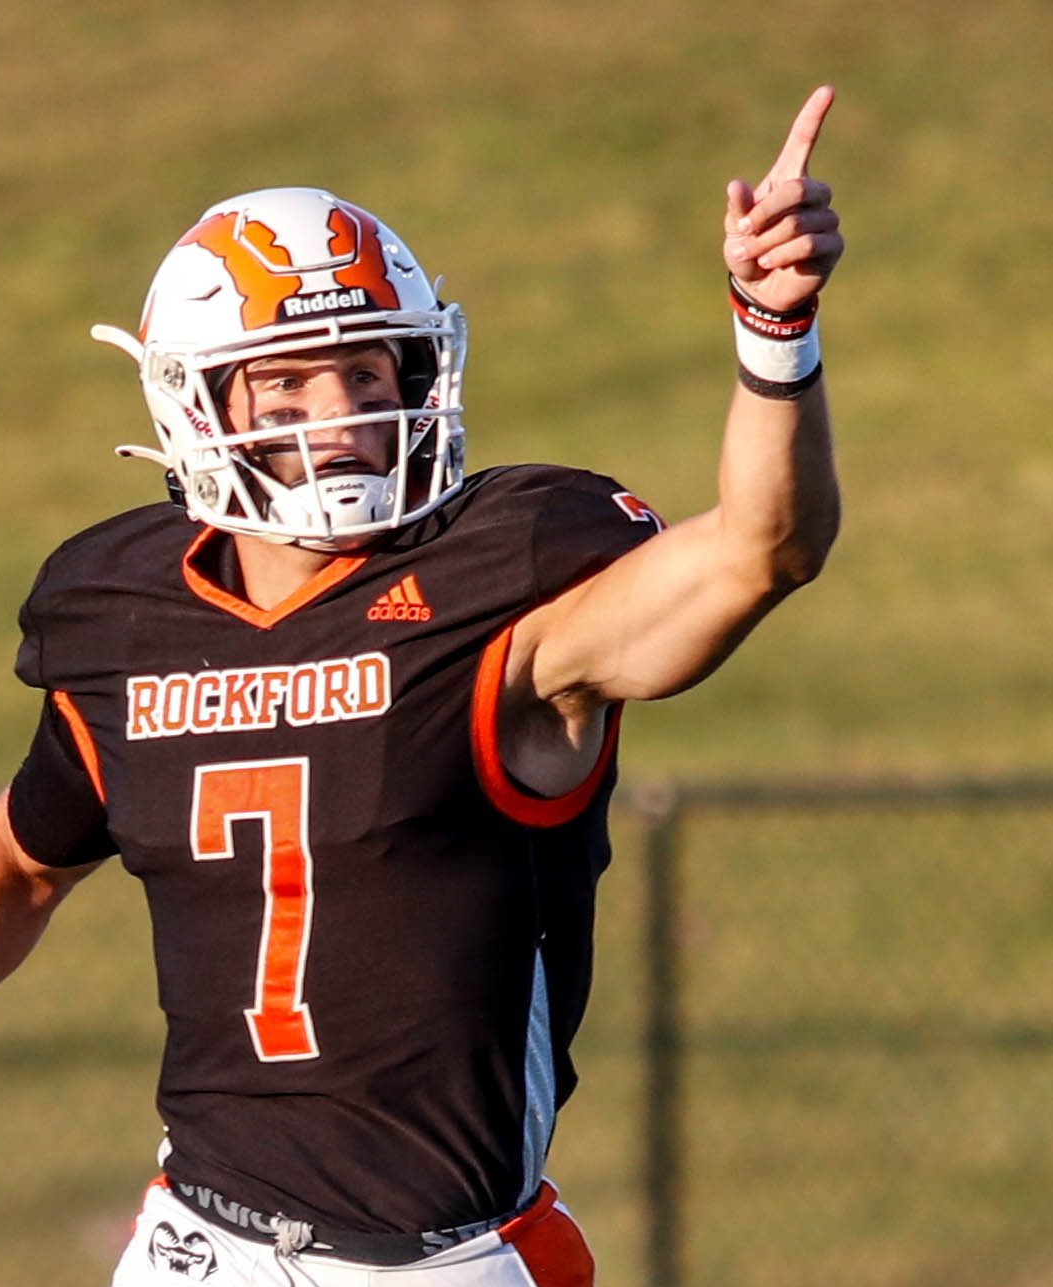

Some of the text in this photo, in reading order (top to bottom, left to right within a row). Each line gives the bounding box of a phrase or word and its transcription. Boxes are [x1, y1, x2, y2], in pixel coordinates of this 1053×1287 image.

[284, 288, 366, 317] Riddell
[366, 603, 432, 621] adidas
[127, 652, 392, 740] ROCKFORD
[192, 757, 320, 1063] 7
